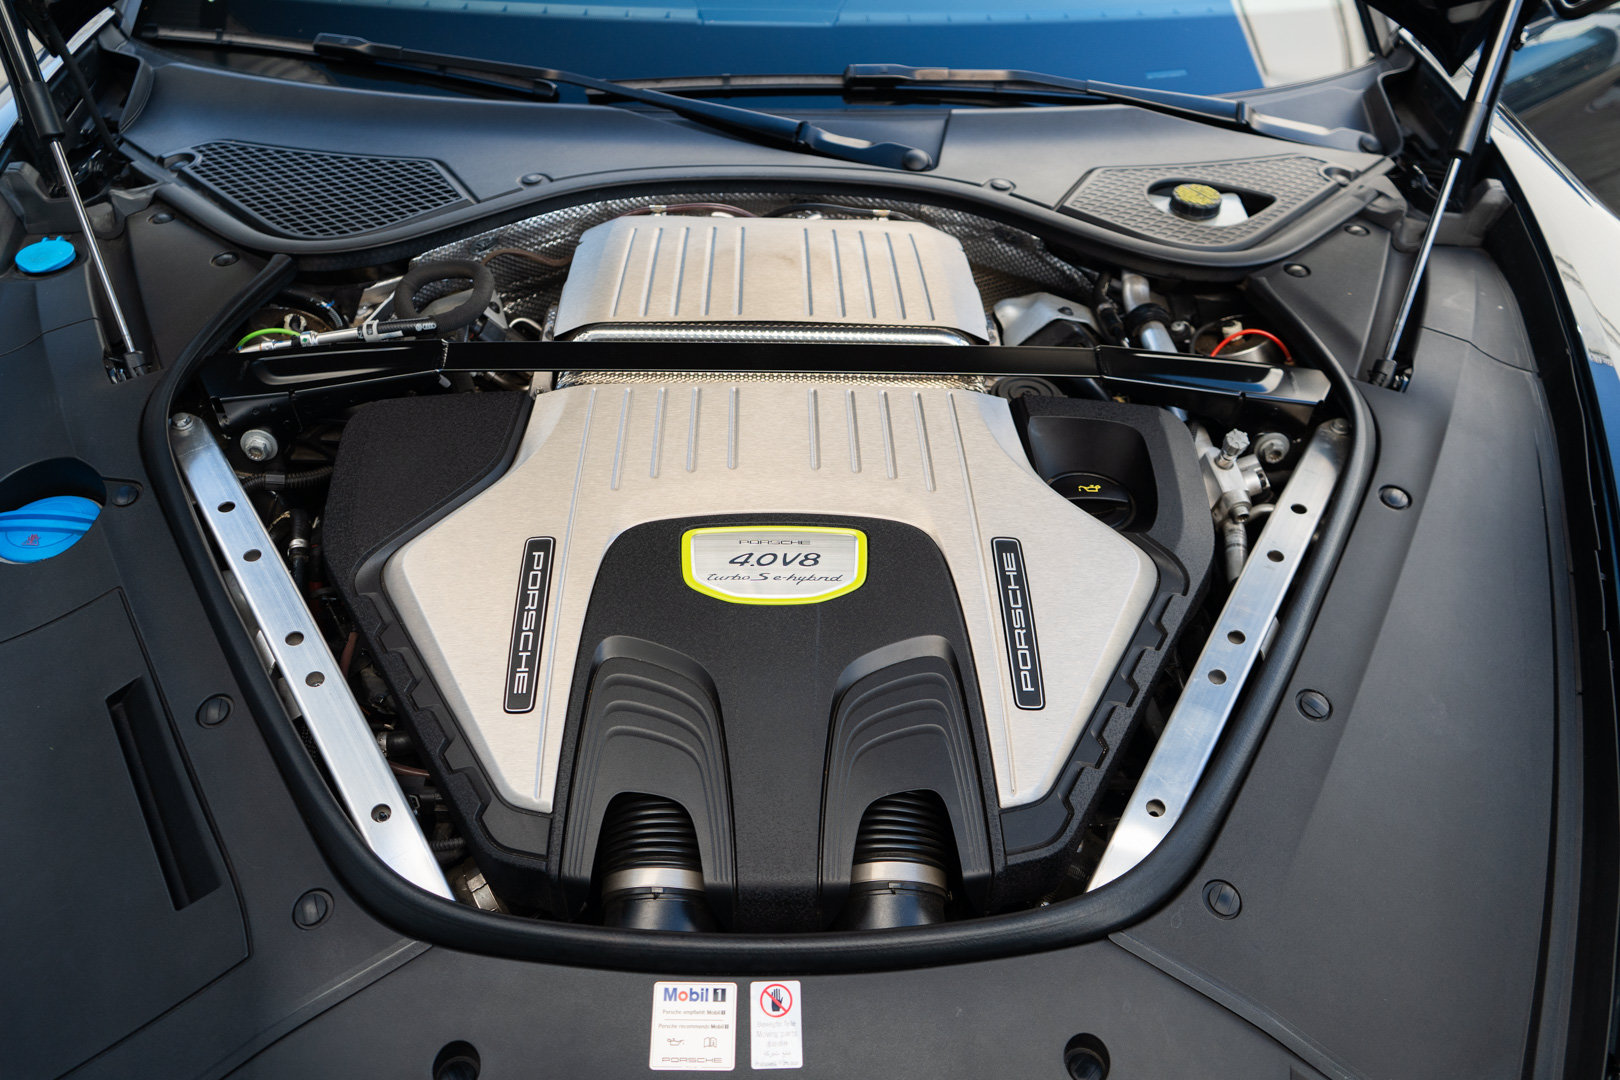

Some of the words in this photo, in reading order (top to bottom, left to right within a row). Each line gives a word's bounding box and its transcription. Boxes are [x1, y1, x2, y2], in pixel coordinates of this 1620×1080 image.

[513, 551, 544, 694] PORSCHE
[1002, 552, 1035, 692] PORSCHE
[663, 987, 709, 1002] Mobil
[661, 1056, 723, 1064] PORSCHE
